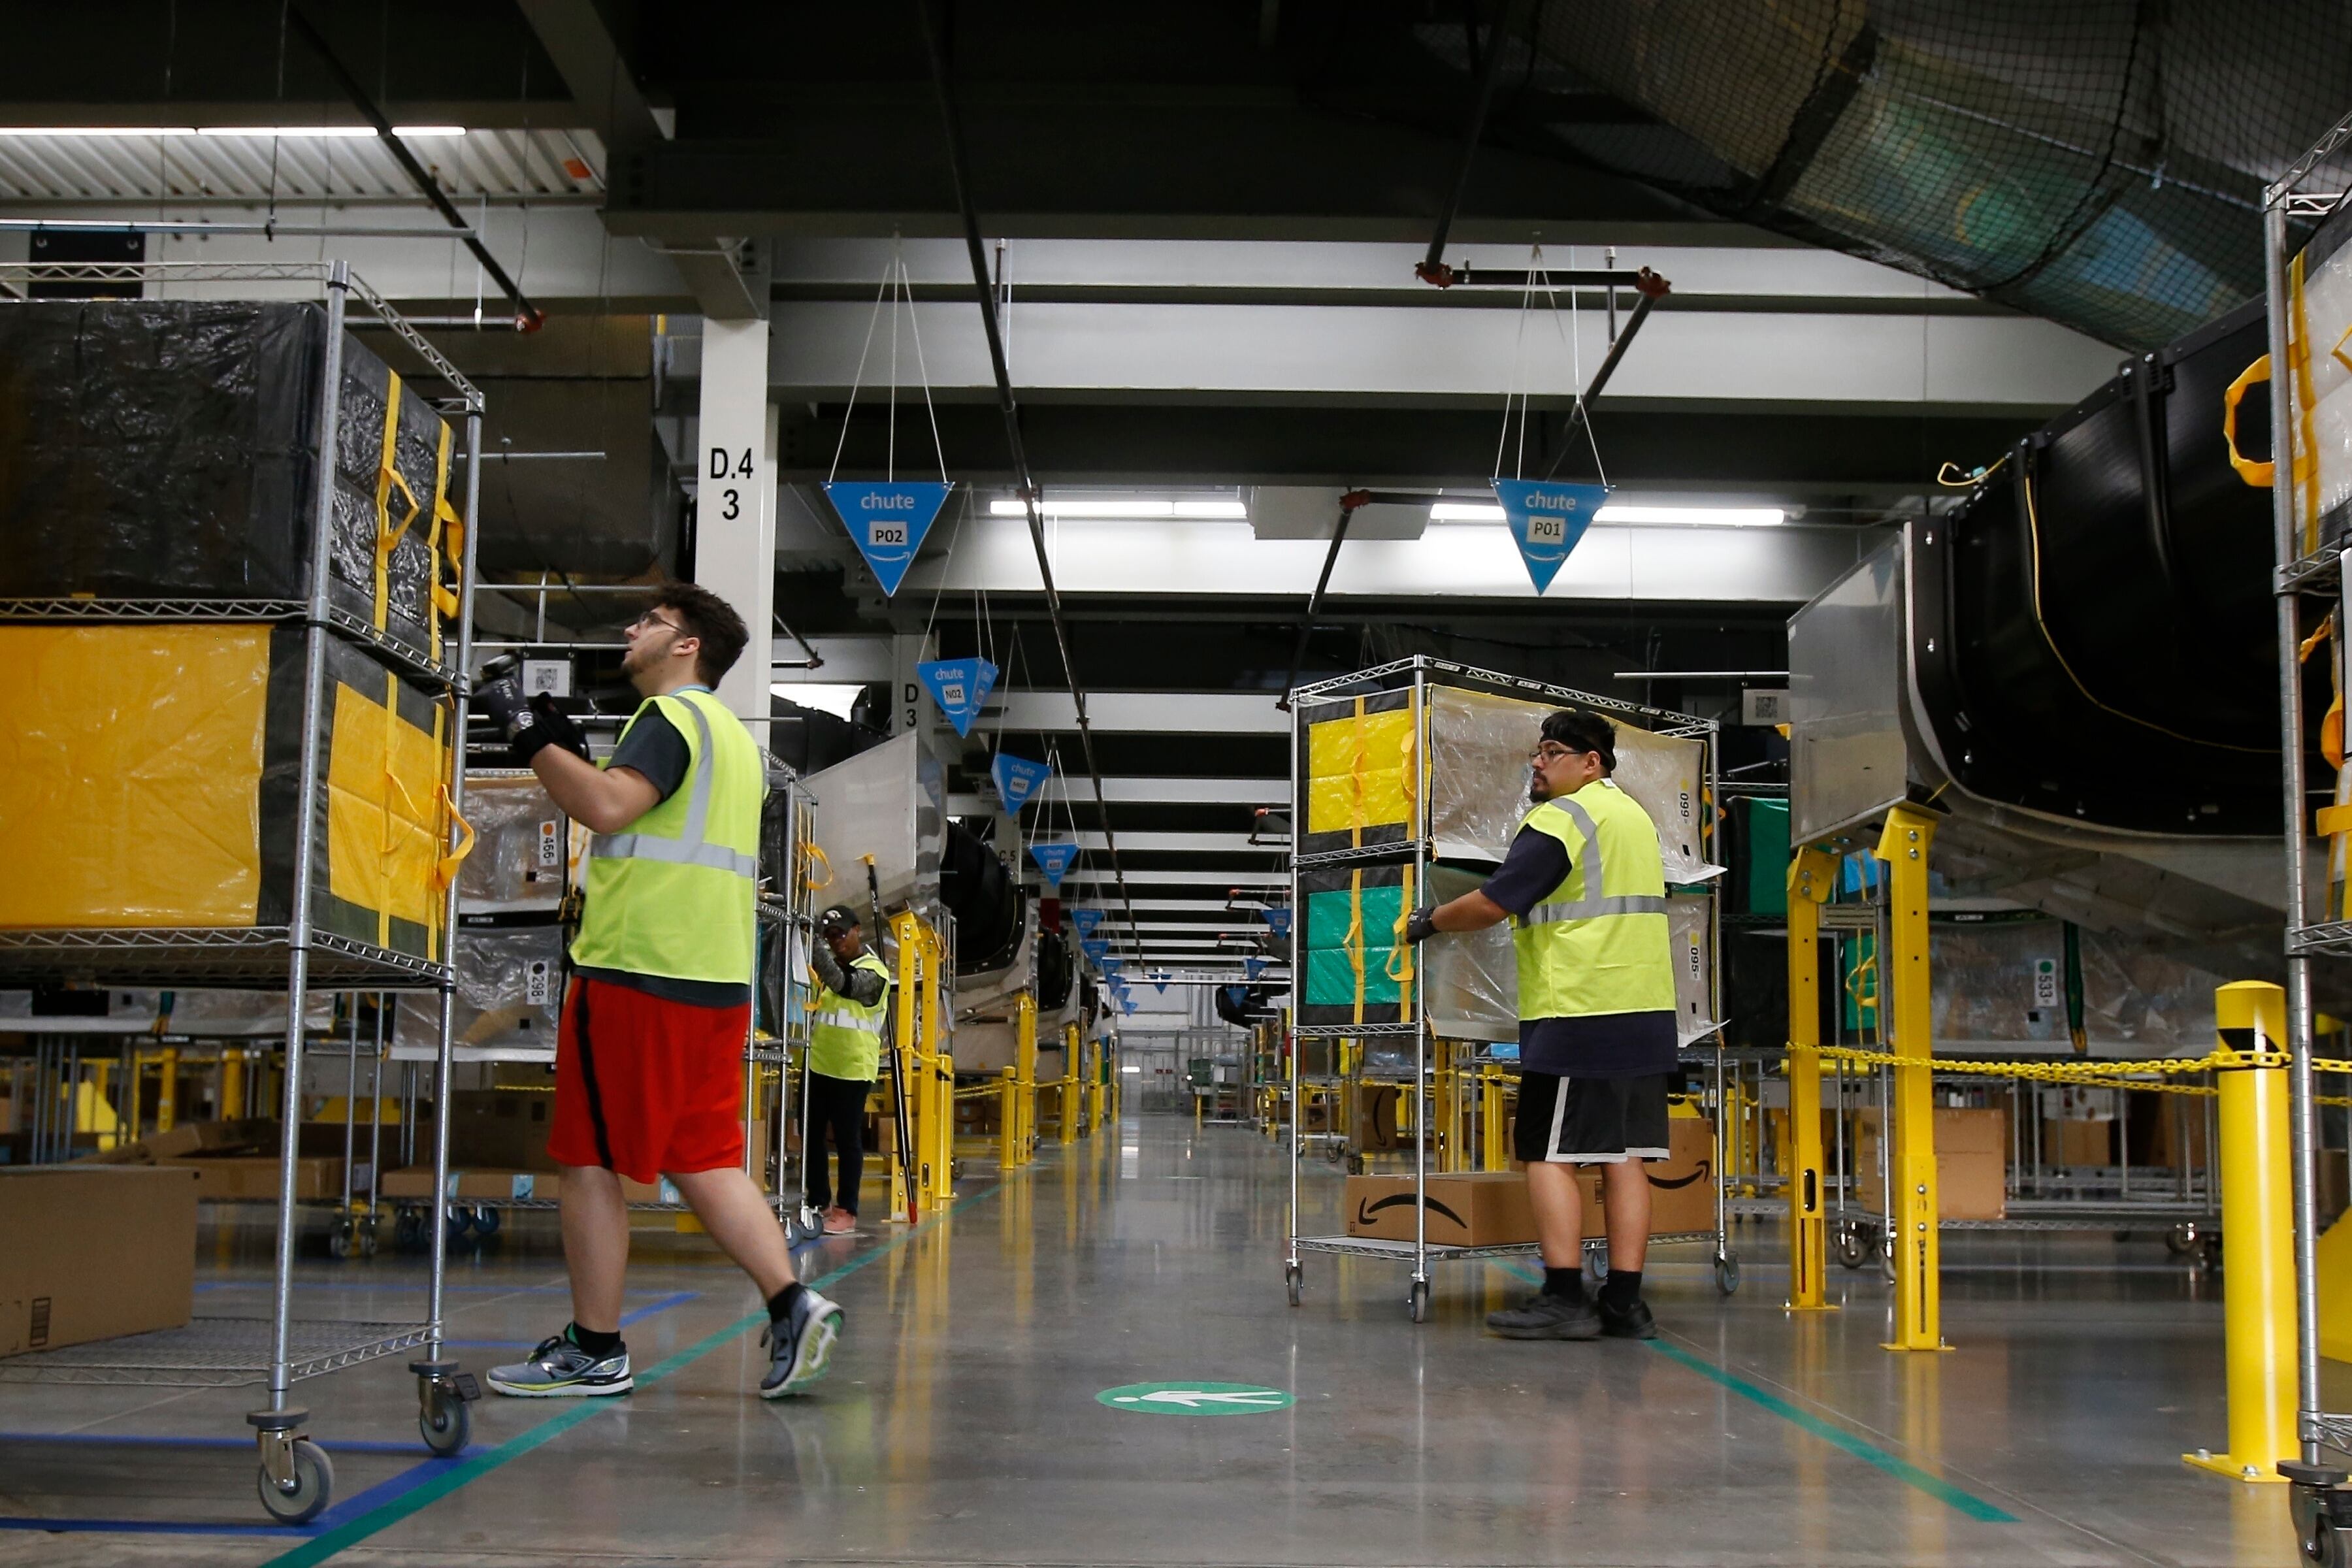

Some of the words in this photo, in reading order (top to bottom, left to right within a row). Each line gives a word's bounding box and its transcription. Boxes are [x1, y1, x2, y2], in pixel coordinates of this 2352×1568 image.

[710, 447, 754, 480] D.4
[722, 488, 740, 521] 3
[860, 491, 915, 510] chute
[1525, 490, 1576, 511] chute
[875, 529, 904, 544] P02
[1534, 521, 1561, 537] P01
[934, 667, 965, 681] chute
[904, 683, 919, 704] D
[945, 689, 963, 700] N02
[906, 708, 917, 728] 3
[1679, 792, 1690, 818] 099
[543, 837, 555, 859] 466
[1690, 947, 1700, 973] 095
[531, 975, 545, 997] 298
[2038, 975, 2053, 998] 533
